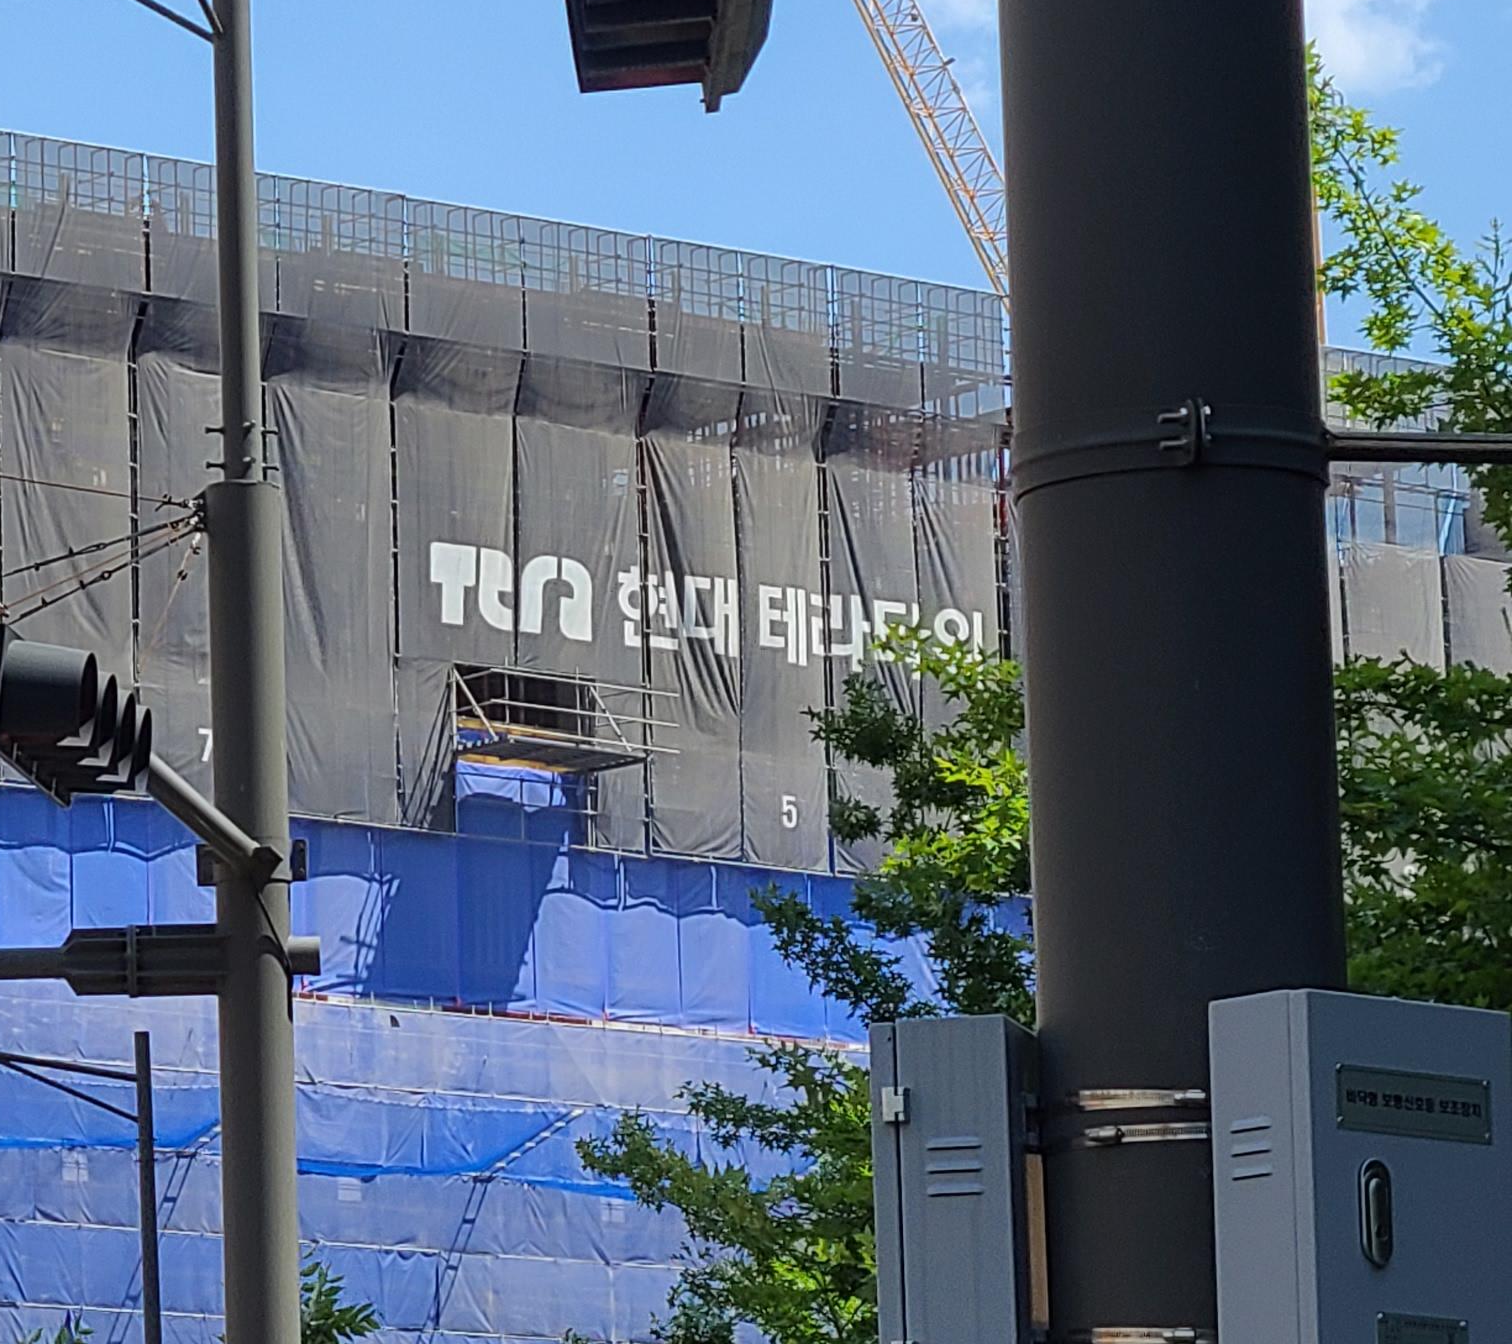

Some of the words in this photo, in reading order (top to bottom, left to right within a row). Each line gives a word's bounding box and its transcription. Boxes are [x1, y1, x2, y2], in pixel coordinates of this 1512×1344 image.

[618, 565, 738, 657] 현대
[198, 727, 213, 762] 7
[781, 794, 798, 829] 5
[1346, 1088, 1378, 1107] 바닥형
[1382, 1092, 1436, 1114] 보행신호등
